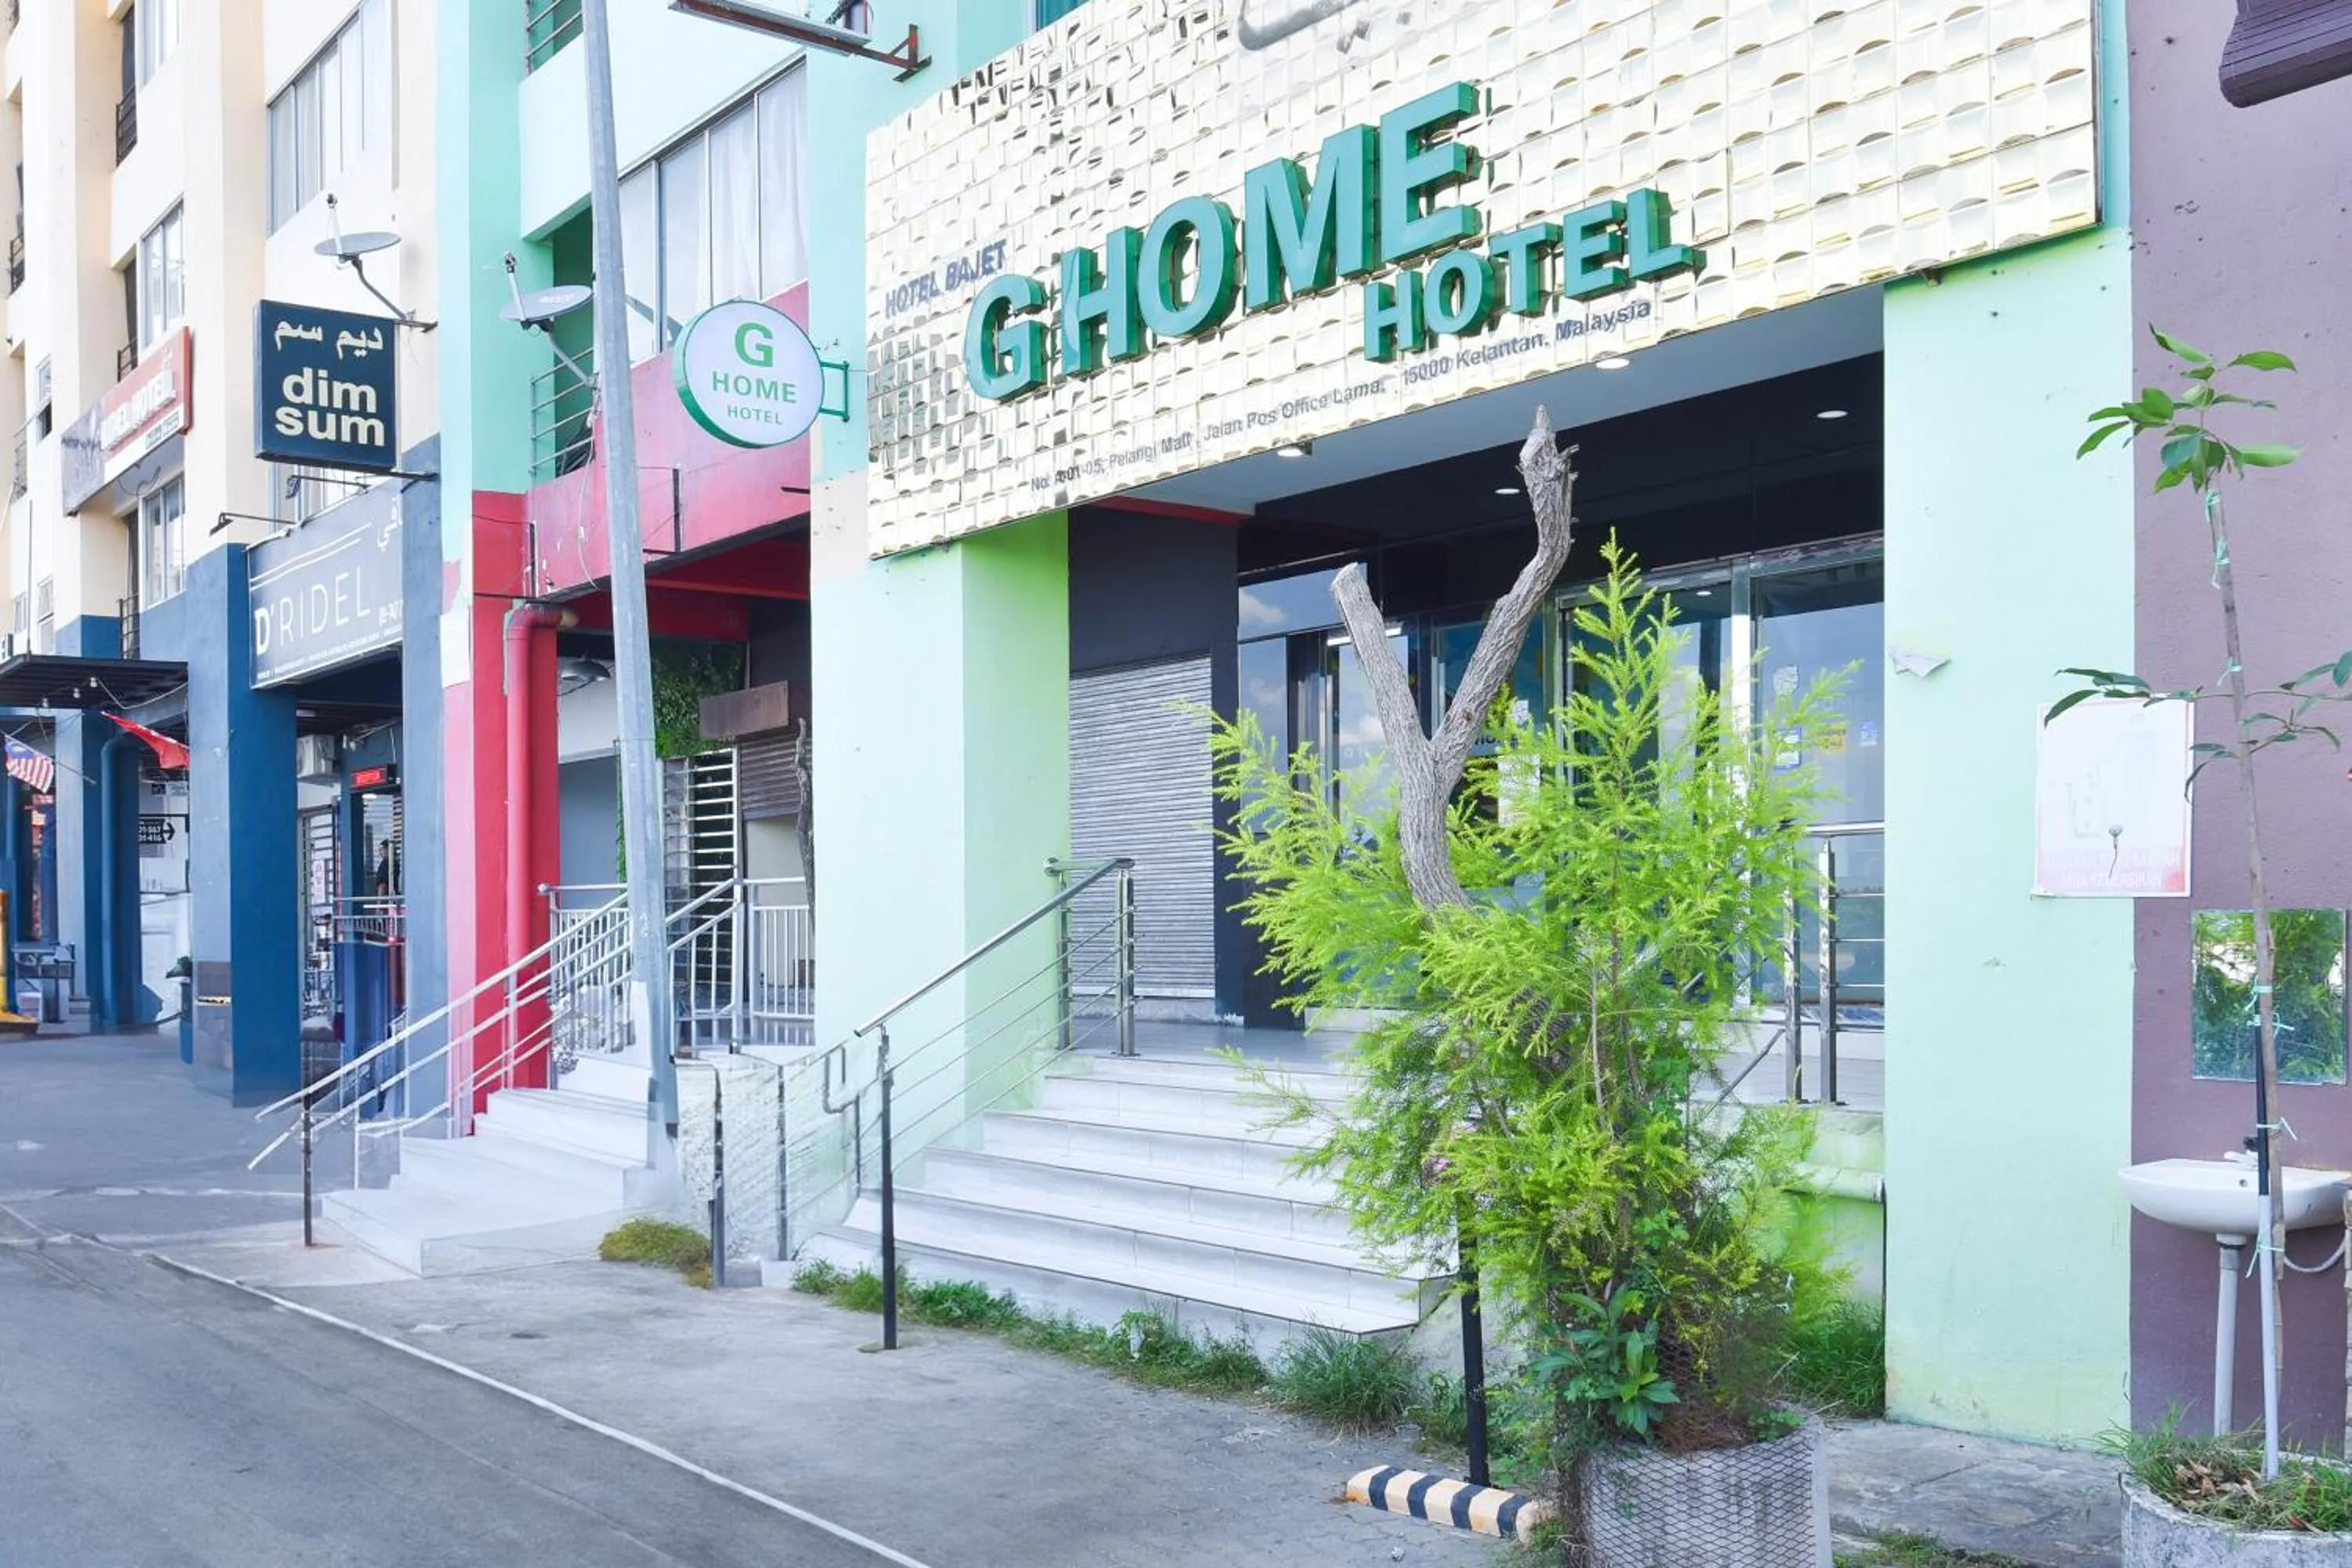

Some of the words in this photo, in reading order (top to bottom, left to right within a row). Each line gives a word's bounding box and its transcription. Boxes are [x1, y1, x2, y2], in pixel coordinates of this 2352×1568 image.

[884, 270, 942, 319] HOTEL
[945, 238, 1007, 292] BAJET
[1363, 187, 1703, 363] HOTEL
[734, 321, 774, 368] G
[281, 366, 377, 414] dim
[712, 370, 797, 404] HOME
[1203, 418, 1243, 441] Jalan
[1247, 408, 1277, 430] Pos
[1281, 396, 1329, 419] Office
[1555, 299, 1653, 343] Malaysia
[274, 405, 386, 447] sum
[727, 404, 783, 426] HOTEL
